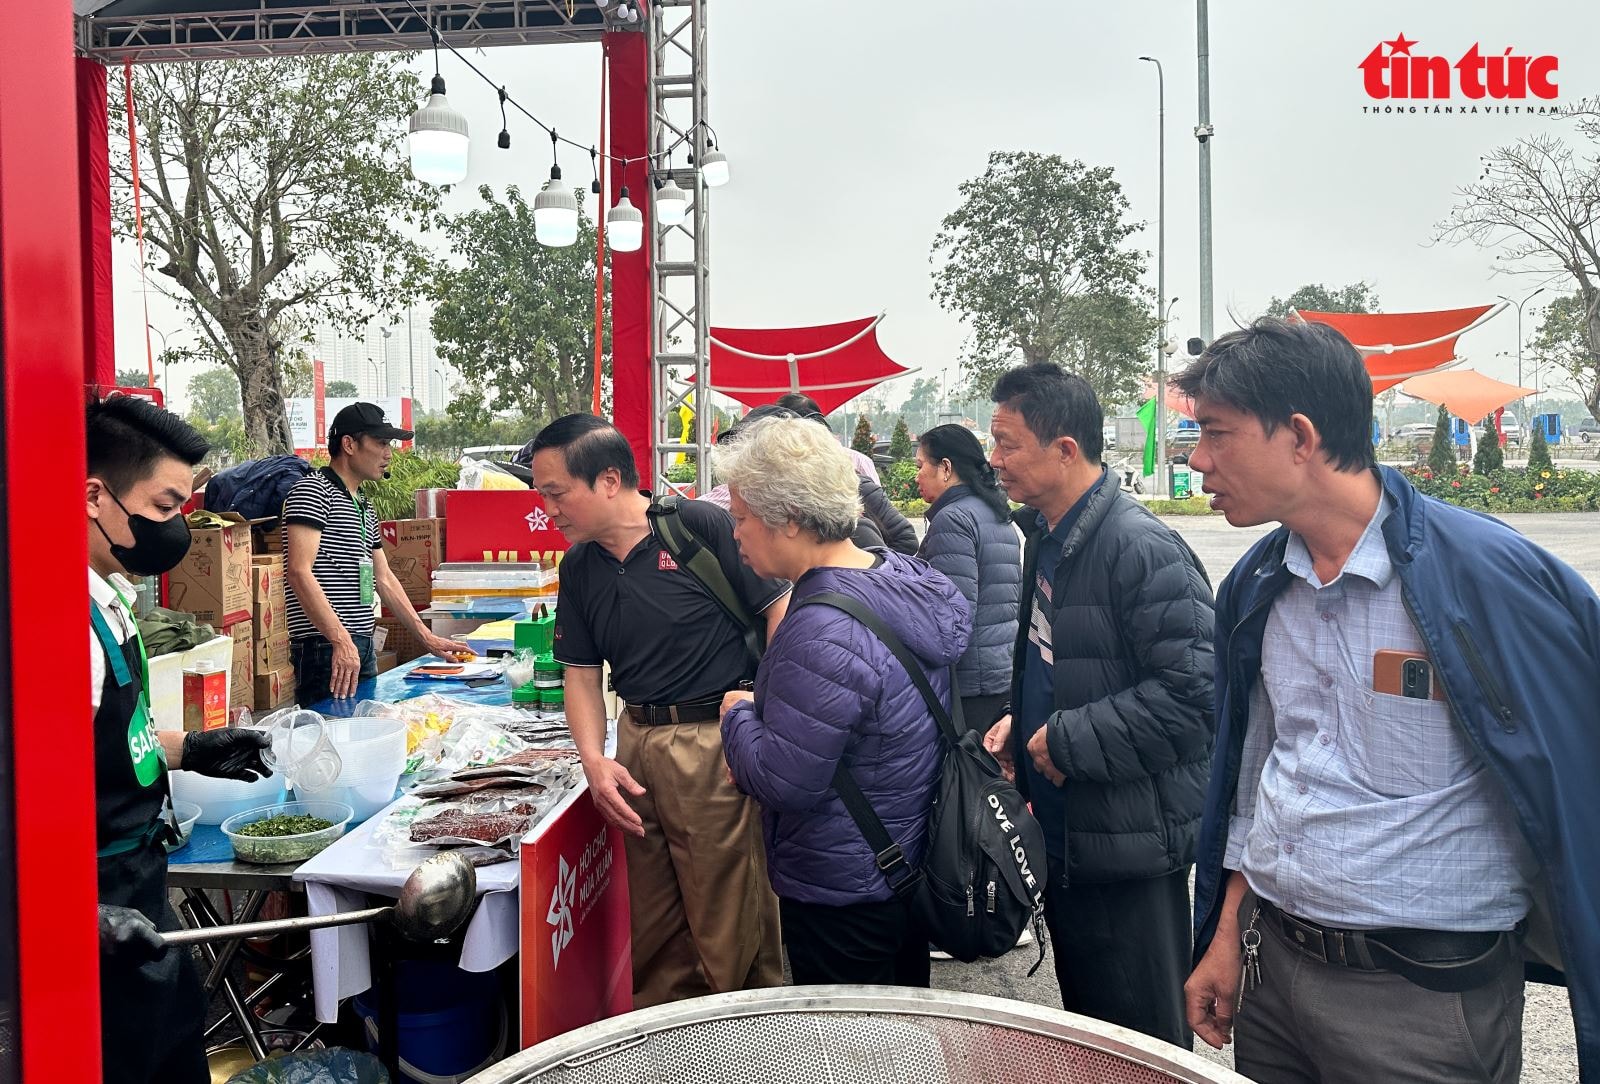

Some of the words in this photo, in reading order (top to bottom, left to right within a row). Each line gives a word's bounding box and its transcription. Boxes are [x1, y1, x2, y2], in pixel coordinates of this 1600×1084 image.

[579, 843, 592, 876] HỘI
[593, 824, 607, 858] CHỢ
[1010, 835, 1036, 888] LOVE
[579, 873, 594, 908] MÙA
[595, 846, 613, 884] XUÂN
